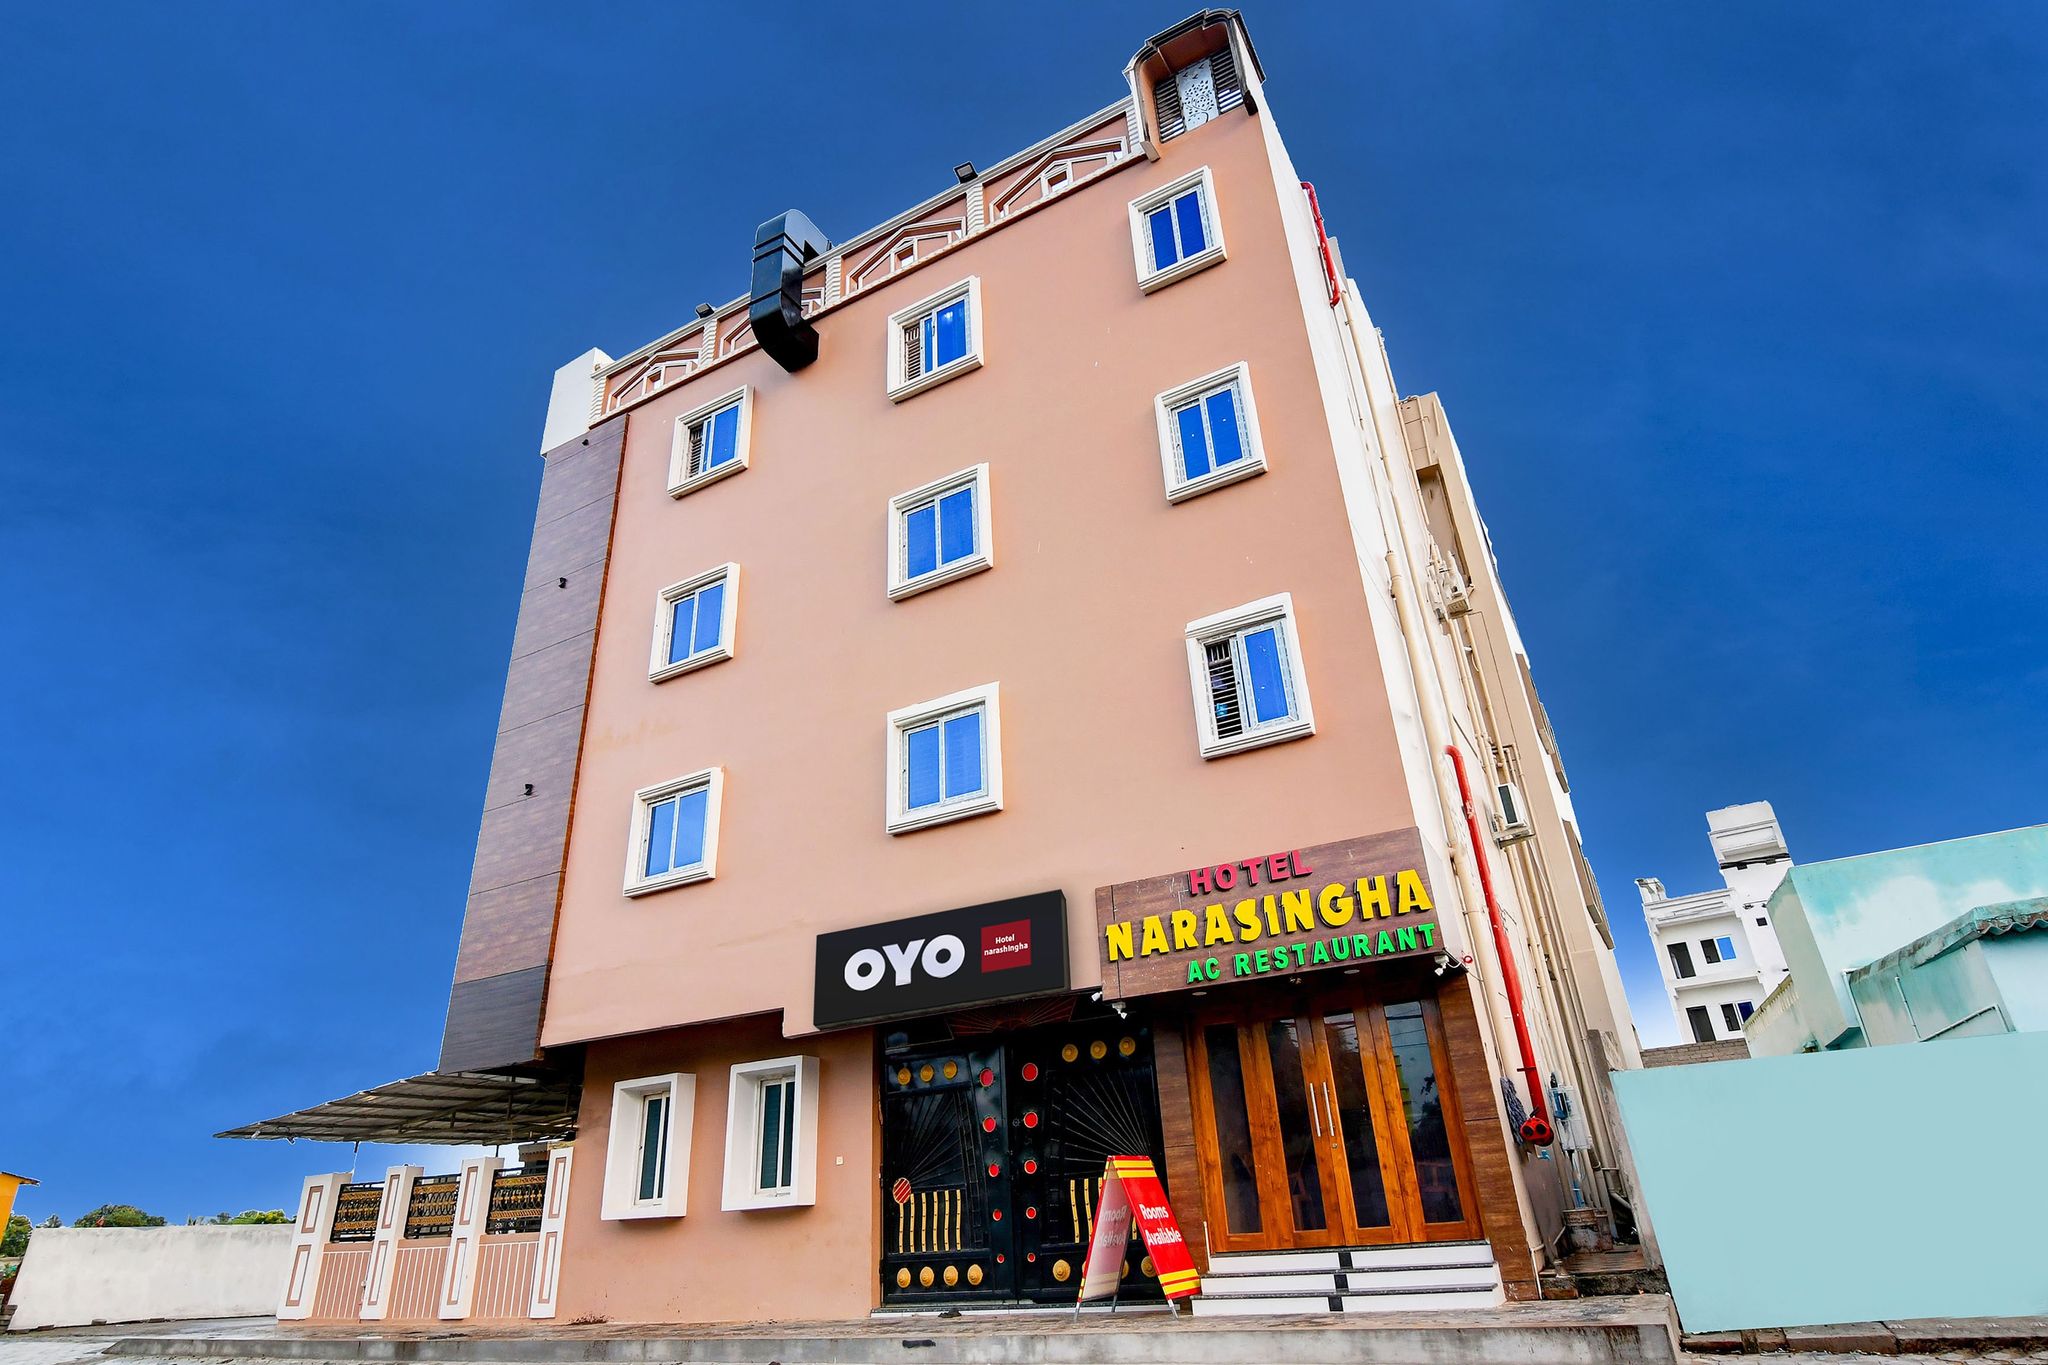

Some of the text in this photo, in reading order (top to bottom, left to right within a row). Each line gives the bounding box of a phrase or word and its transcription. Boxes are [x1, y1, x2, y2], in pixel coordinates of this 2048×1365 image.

[1188, 850, 1313, 896] HOTEL
[1105, 869, 1433, 962] NARASINGHA
[984, 942, 1028, 956] narashingha
[995, 933, 1015, 945] Hotel
[1187, 923, 1435, 984] AC RESTAURANT
[844, 934, 965, 991] OYO
[1139, 1203, 1169, 1220] Rooms
[1145, 1226, 1182, 1246] Available
